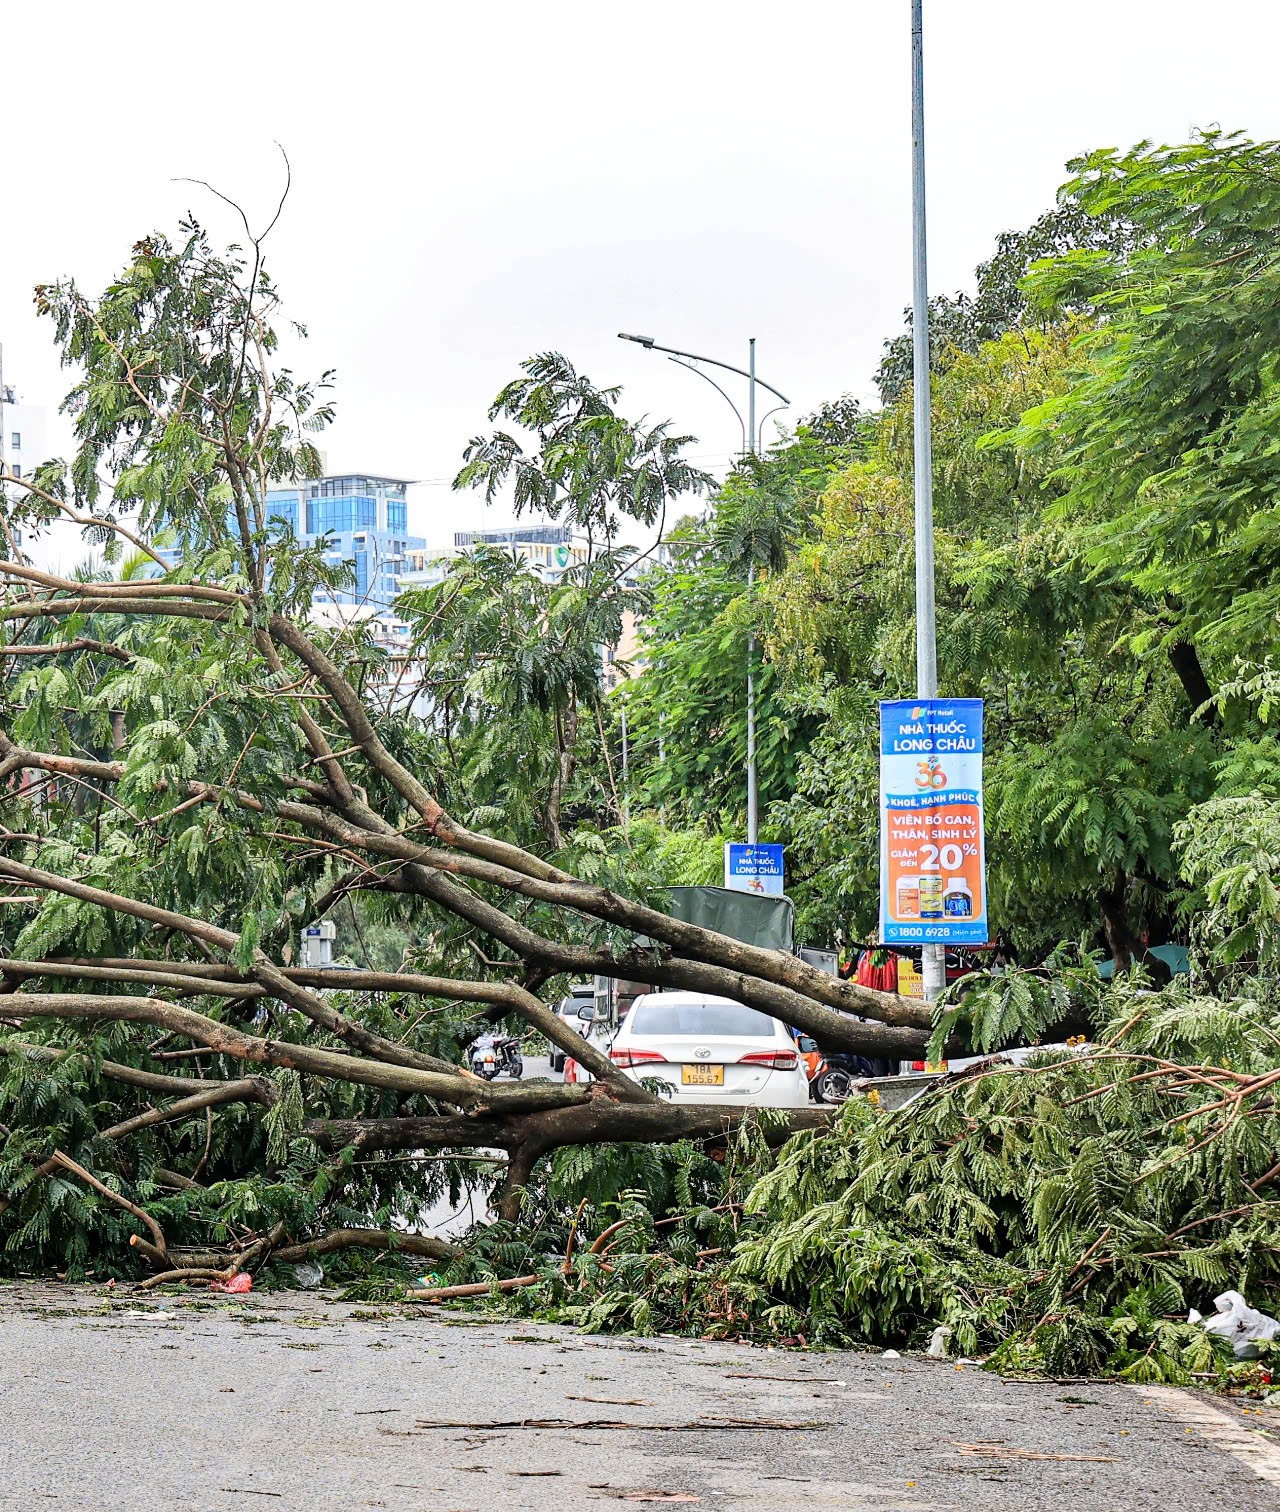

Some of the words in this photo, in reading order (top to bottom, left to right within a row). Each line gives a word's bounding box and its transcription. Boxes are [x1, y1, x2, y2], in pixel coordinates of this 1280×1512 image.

[900, 722, 924, 734] NHÀ
[926, 720, 966, 734] THUỐC
[894, 739, 933, 752] LONG
[936, 736, 976, 750] CHÂU
[922, 795, 946, 806] HẠNH
[893, 814, 922, 825] VIÊN
[945, 816, 975, 826] GAN,
[932, 830, 960, 839] SINH
[963, 827, 977, 839] LÝ
[891, 848, 918, 858] GIẢM
[920, 844, 977, 871] 20%
[754, 857, 774, 865] THUỐC
[759, 865, 779, 874] CHÂU
[899, 928, 922, 936] 1800
[925, 928, 950, 936] 6928
[696, 1064, 711, 1074] 18A
[688, 1075, 719, 1084] 155.67
